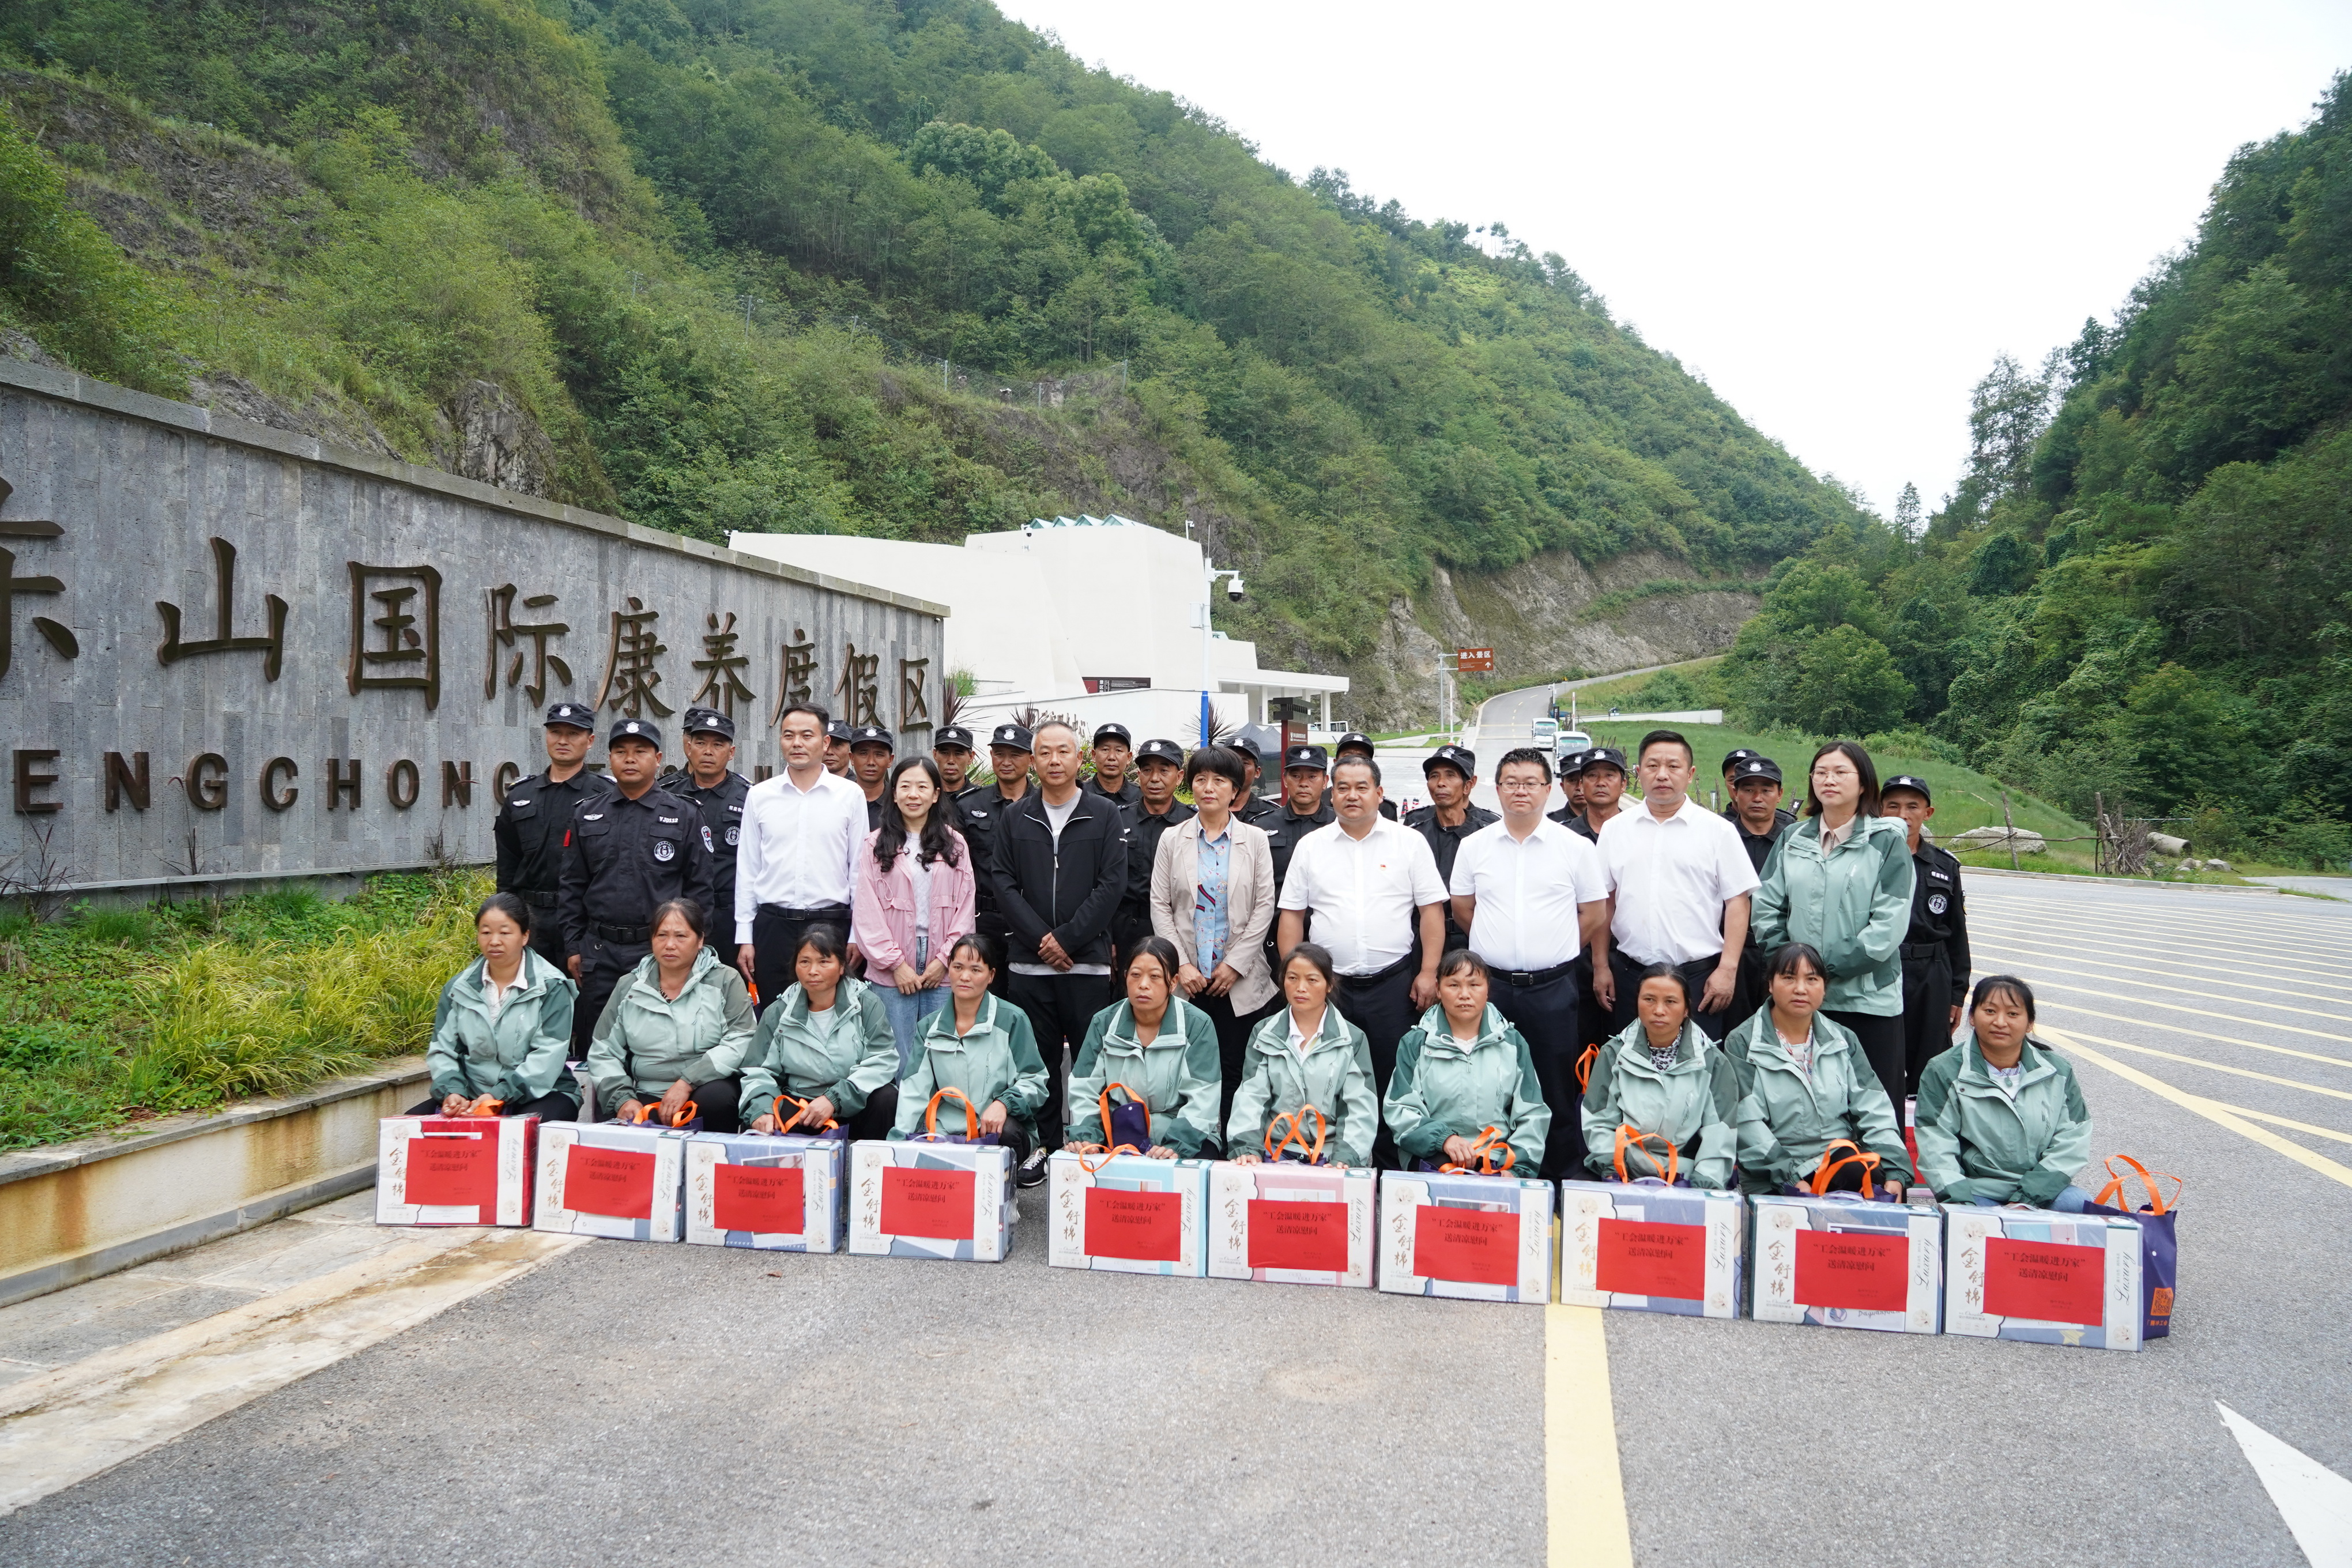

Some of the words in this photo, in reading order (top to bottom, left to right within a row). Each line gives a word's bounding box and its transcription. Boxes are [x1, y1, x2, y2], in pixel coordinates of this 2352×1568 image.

[1460, 651, 1491, 659] 进入景区
[811, 1169, 828, 1214] Luxury
[980, 1172, 998, 1219] Luxury
[1111, 1213, 1151, 1224] 送清凉慰问
[1181, 1188, 1197, 1235] Luxury
[1348, 1197, 1367, 1245] Luxury
[1276, 1225, 1318, 1235] 送清凉慰问
[1444, 1232, 1487, 1246] 送清凉慰问
[1526, 1210, 1546, 1260] Luxury
[1628, 1247, 1672, 1260] 送清凉慰问
[1711, 1222, 1732, 1273] Luxury
[2004, 1252, 2086, 1268] “工会温暖进万家”
[1827, 1259, 1875, 1272] 送清凉慰问
[1914, 1238, 1936, 1290] Luxury
[2018, 1268, 2068, 1282] 送清凉慰问
[2113, 1251, 2136, 1306] Luxury
